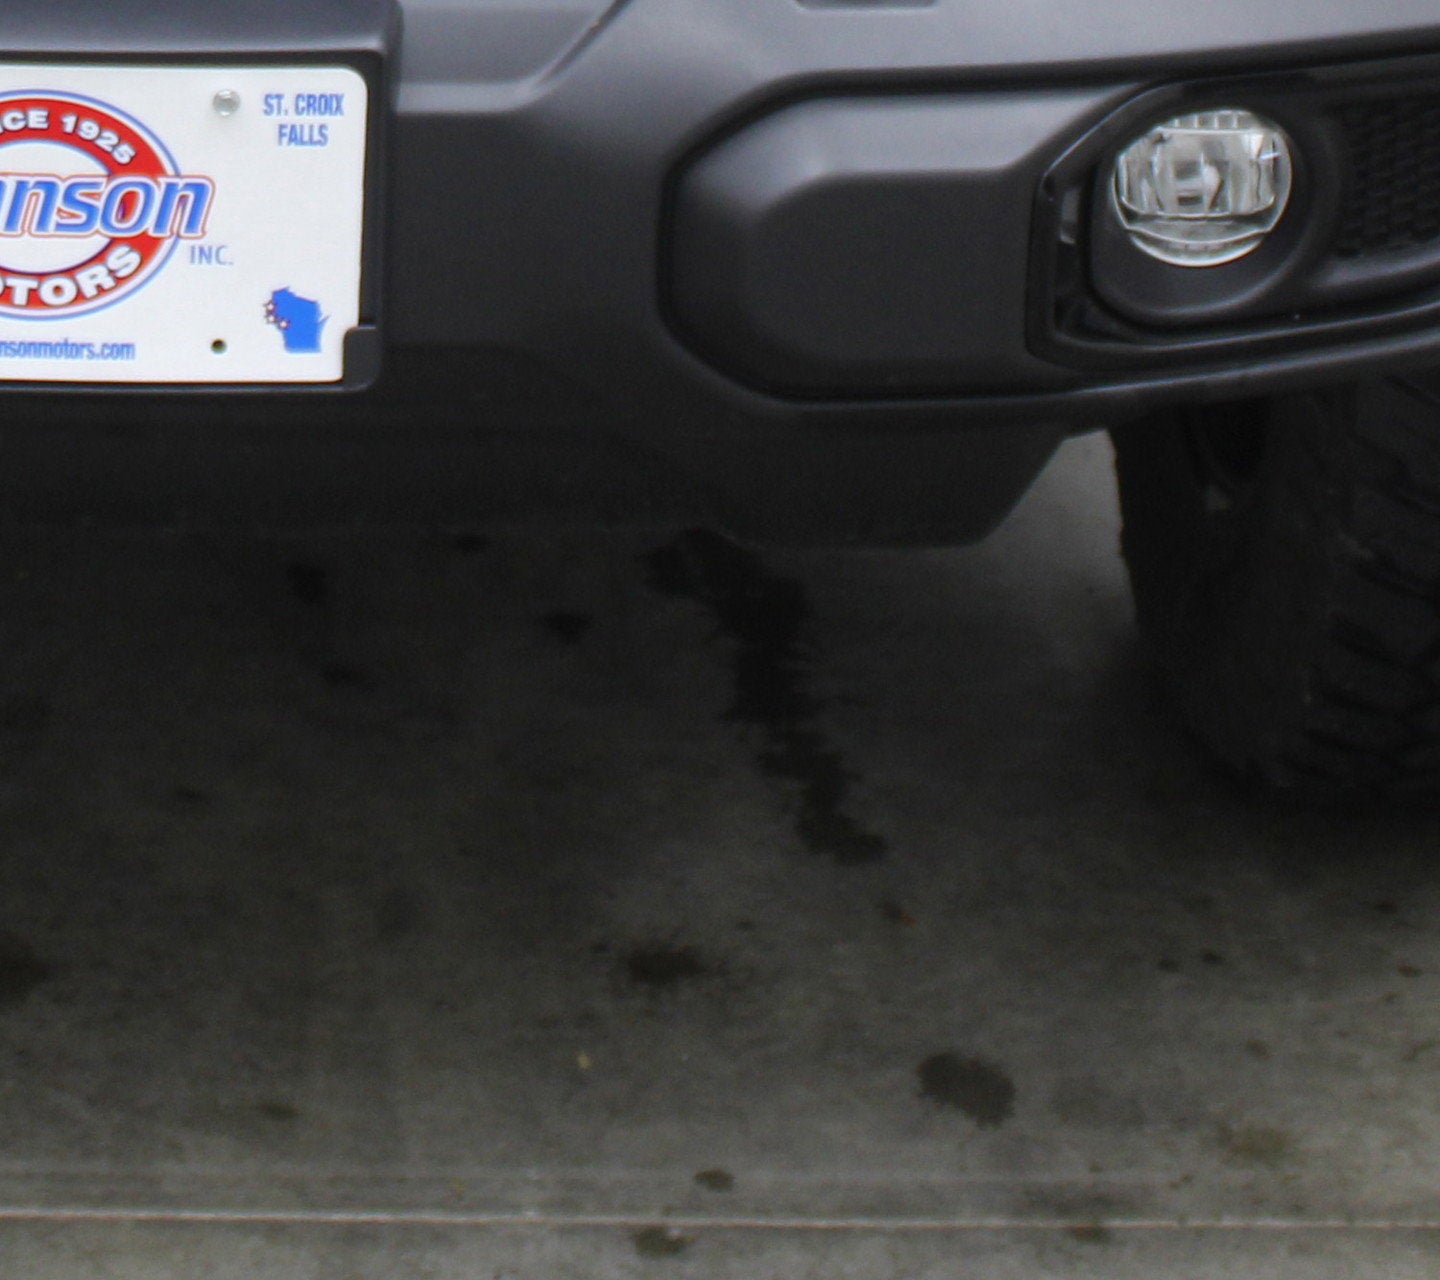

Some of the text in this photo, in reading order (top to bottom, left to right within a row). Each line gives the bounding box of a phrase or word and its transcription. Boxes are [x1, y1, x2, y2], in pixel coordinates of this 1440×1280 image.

[262, 93, 345, 116] ST. CROIX
[61, 113, 137, 165] 1925
[277, 123, 330, 147] FALLS
[189, 244, 234, 266] INC.
